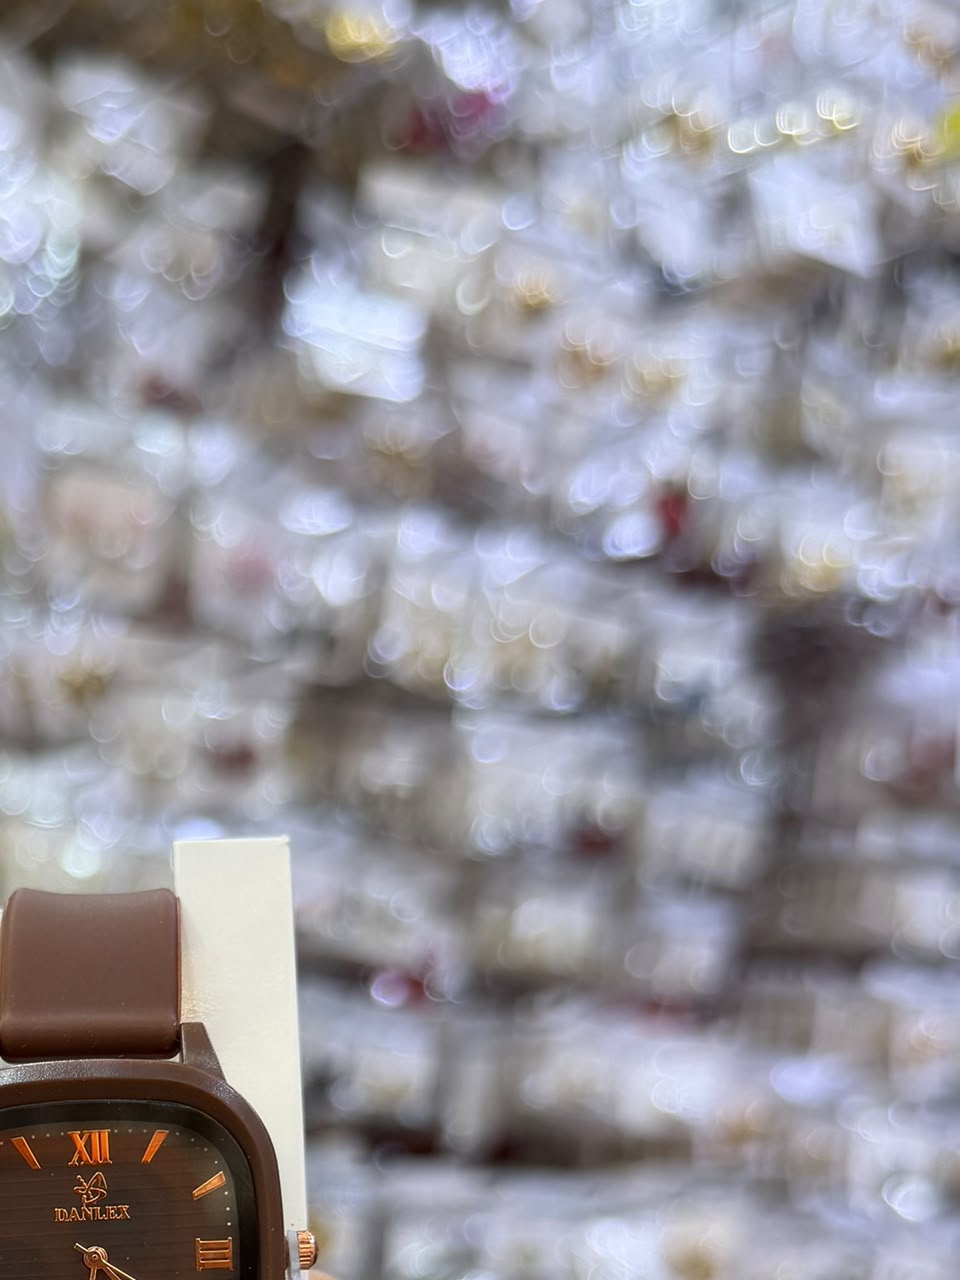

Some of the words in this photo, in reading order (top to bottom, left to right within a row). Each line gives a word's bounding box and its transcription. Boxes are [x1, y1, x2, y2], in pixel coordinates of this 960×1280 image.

[67, 1129, 112, 1166] XII
[54, 1204, 131, 1222] DANLEX
[195, 1236, 233, 1271] III
